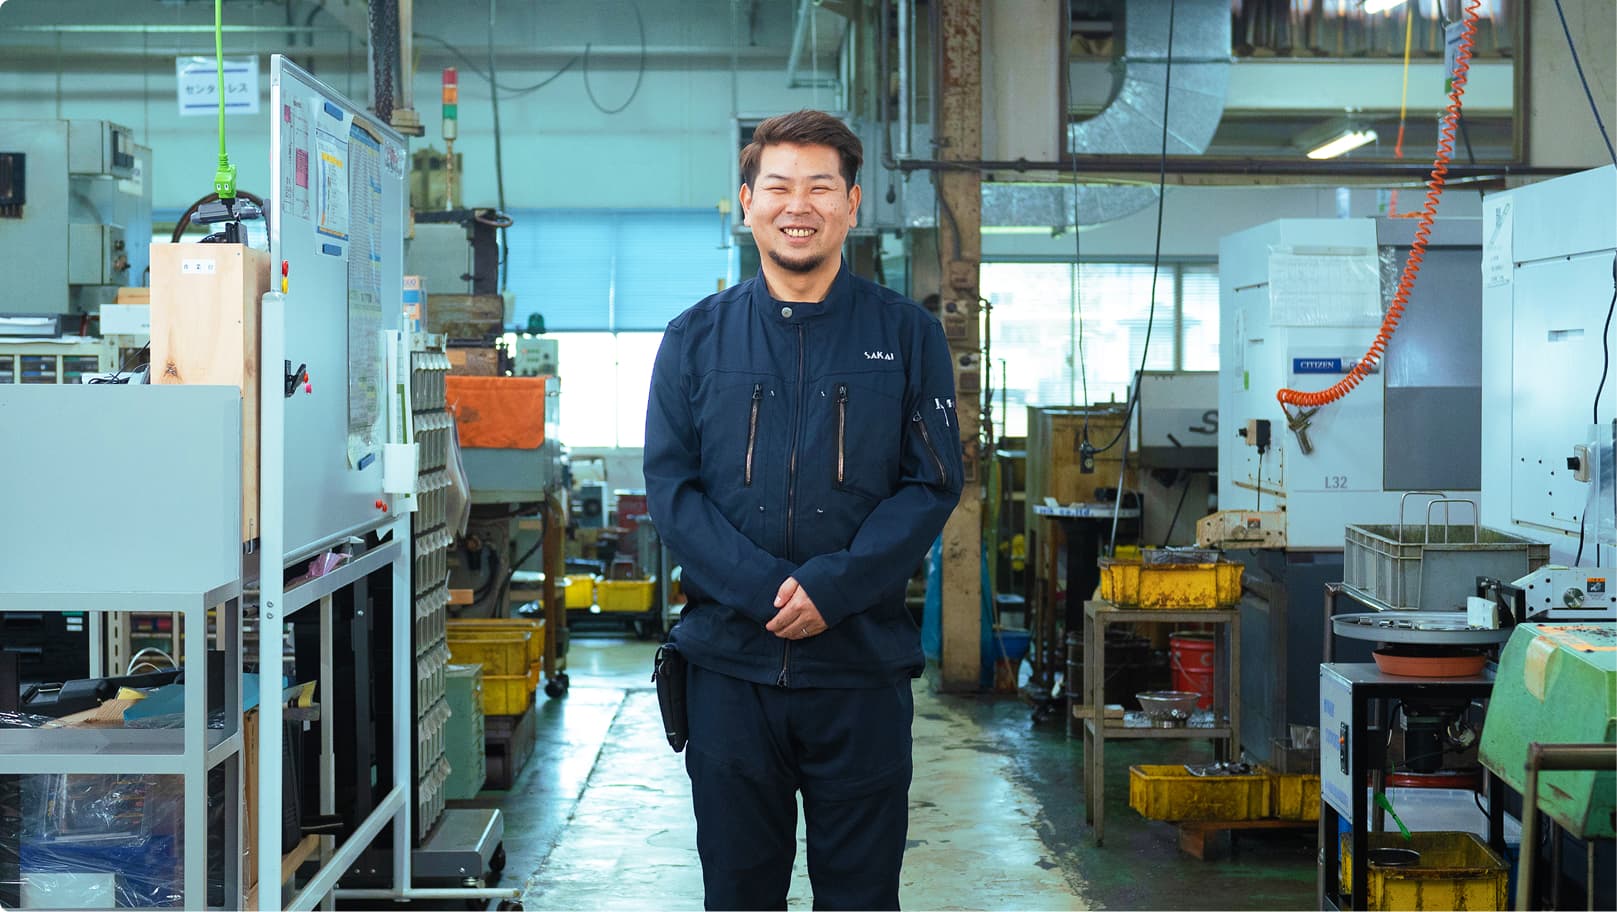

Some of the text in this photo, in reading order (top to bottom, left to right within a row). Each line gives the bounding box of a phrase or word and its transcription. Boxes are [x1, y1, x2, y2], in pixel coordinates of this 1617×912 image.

[186, 84, 248, 94] センタレス
[864, 351, 894, 361] SAKAI
[1300, 360, 1334, 369] CITIZEN
[1325, 475, 1348, 489] L32
